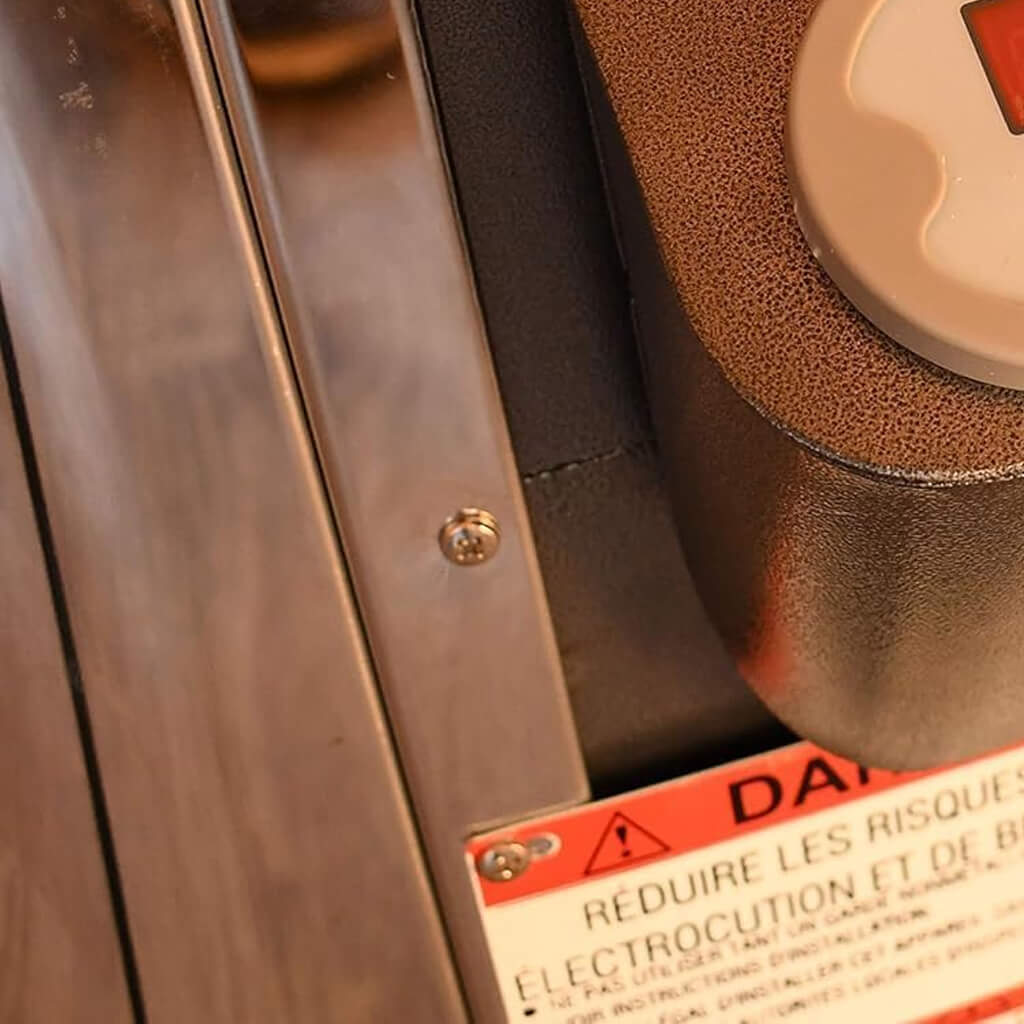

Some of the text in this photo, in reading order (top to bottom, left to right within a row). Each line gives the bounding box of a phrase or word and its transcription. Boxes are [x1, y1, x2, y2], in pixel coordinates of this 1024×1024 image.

[728, 755, 869, 826] DA
[583, 850, 764, 931] RÉDUIRE
[776, 822, 852, 874] LES
[870, 851, 917, 892] ET
[930, 829, 977, 872] DE
